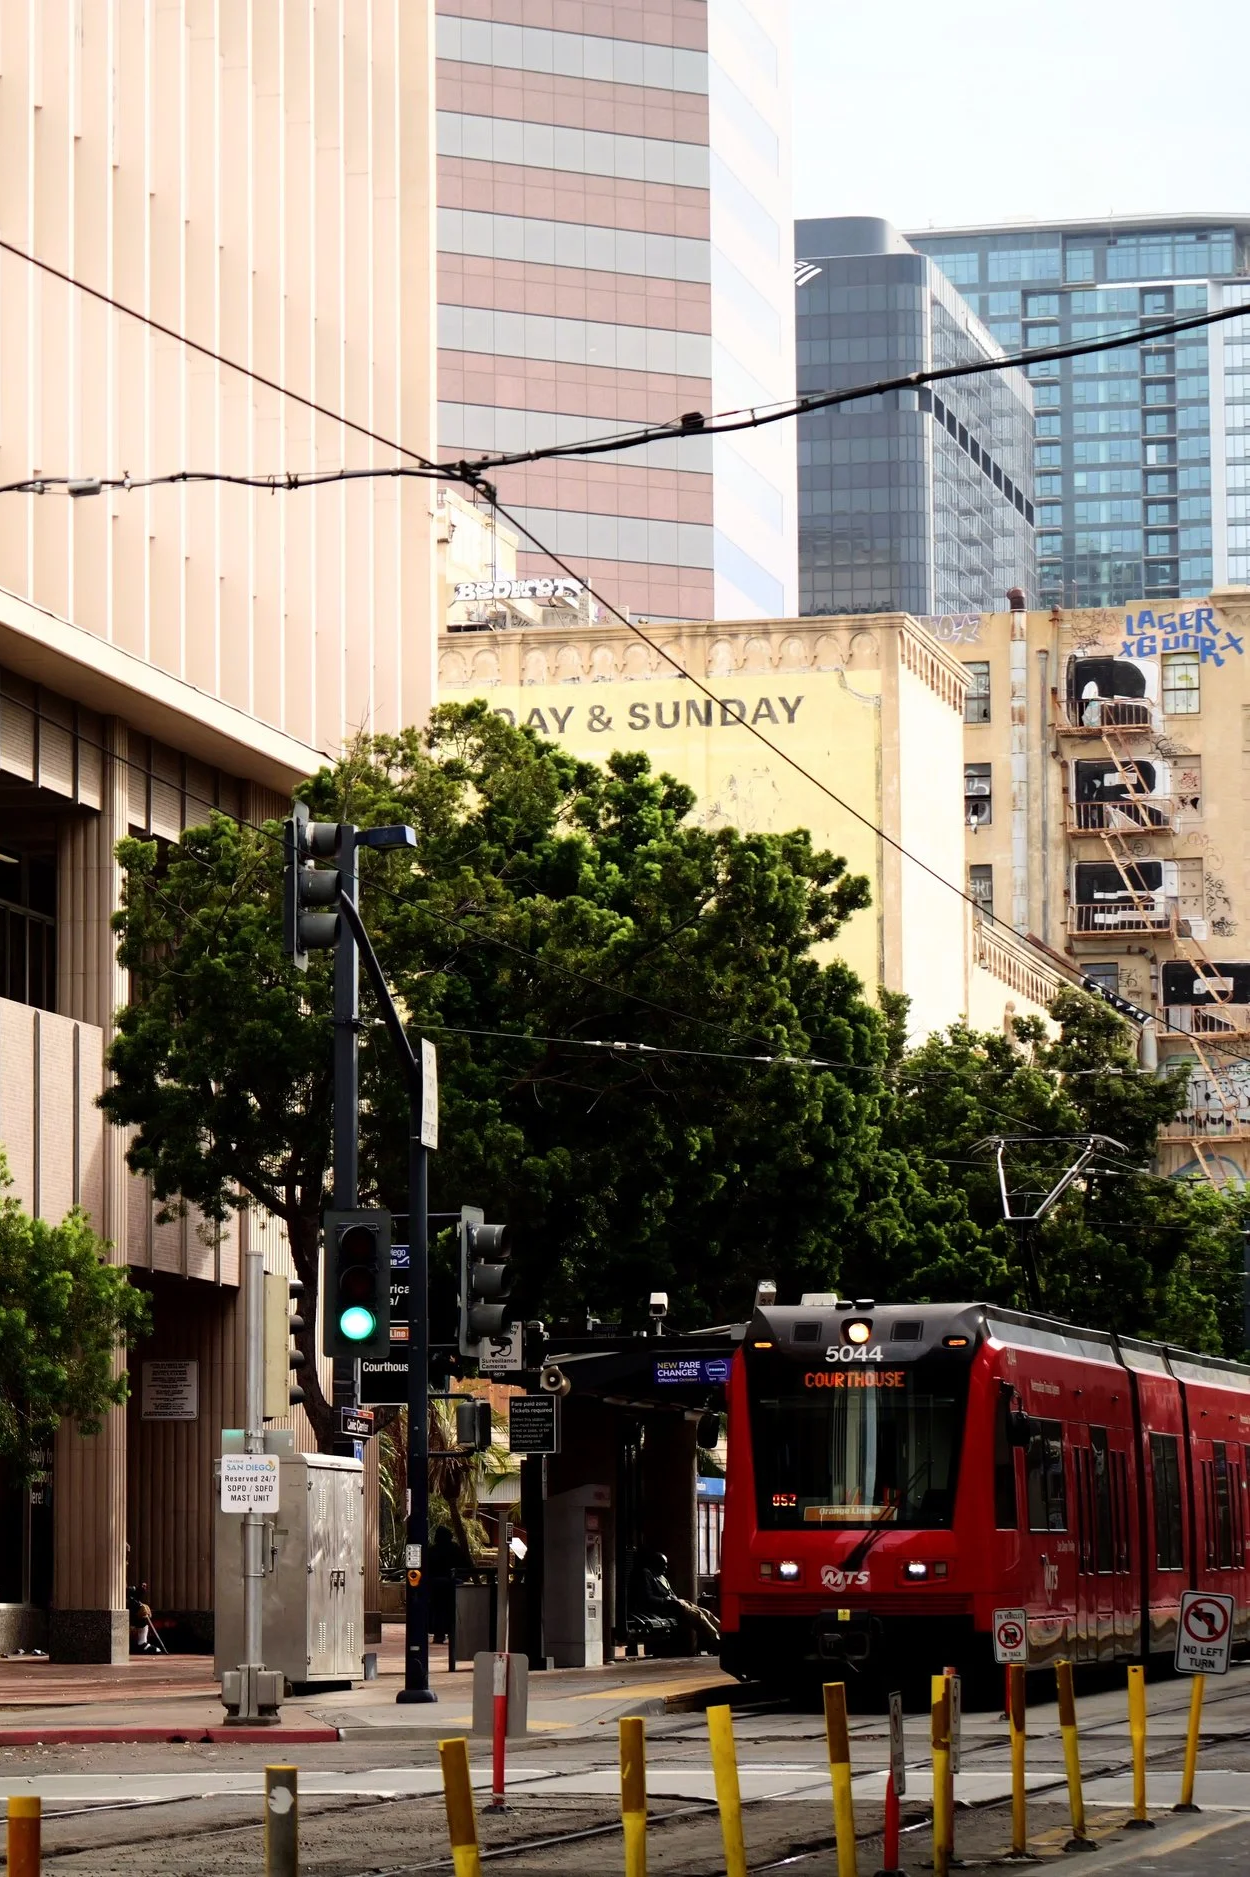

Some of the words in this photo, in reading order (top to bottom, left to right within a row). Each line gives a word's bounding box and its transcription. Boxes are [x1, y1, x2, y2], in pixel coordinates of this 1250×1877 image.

[586, 704, 615, 732] &
[627, 695, 805, 731] SUNDAY
[390, 1329, 406, 1338] Line
[825, 1345, 883, 1362] 5044
[805, 1371, 905, 1388] COURTHOUSE
[772, 1494, 796, 1506] 052
[819, 1507, 850, 1516] Orange
[852, 1507, 869, 1515] Line
[821, 1571, 870, 1585] MTS
[1183, 1645, 1197, 1655] NO
[1200, 1647, 1224, 1657] LEFT
[1189, 1657, 1215, 1669] TURN
